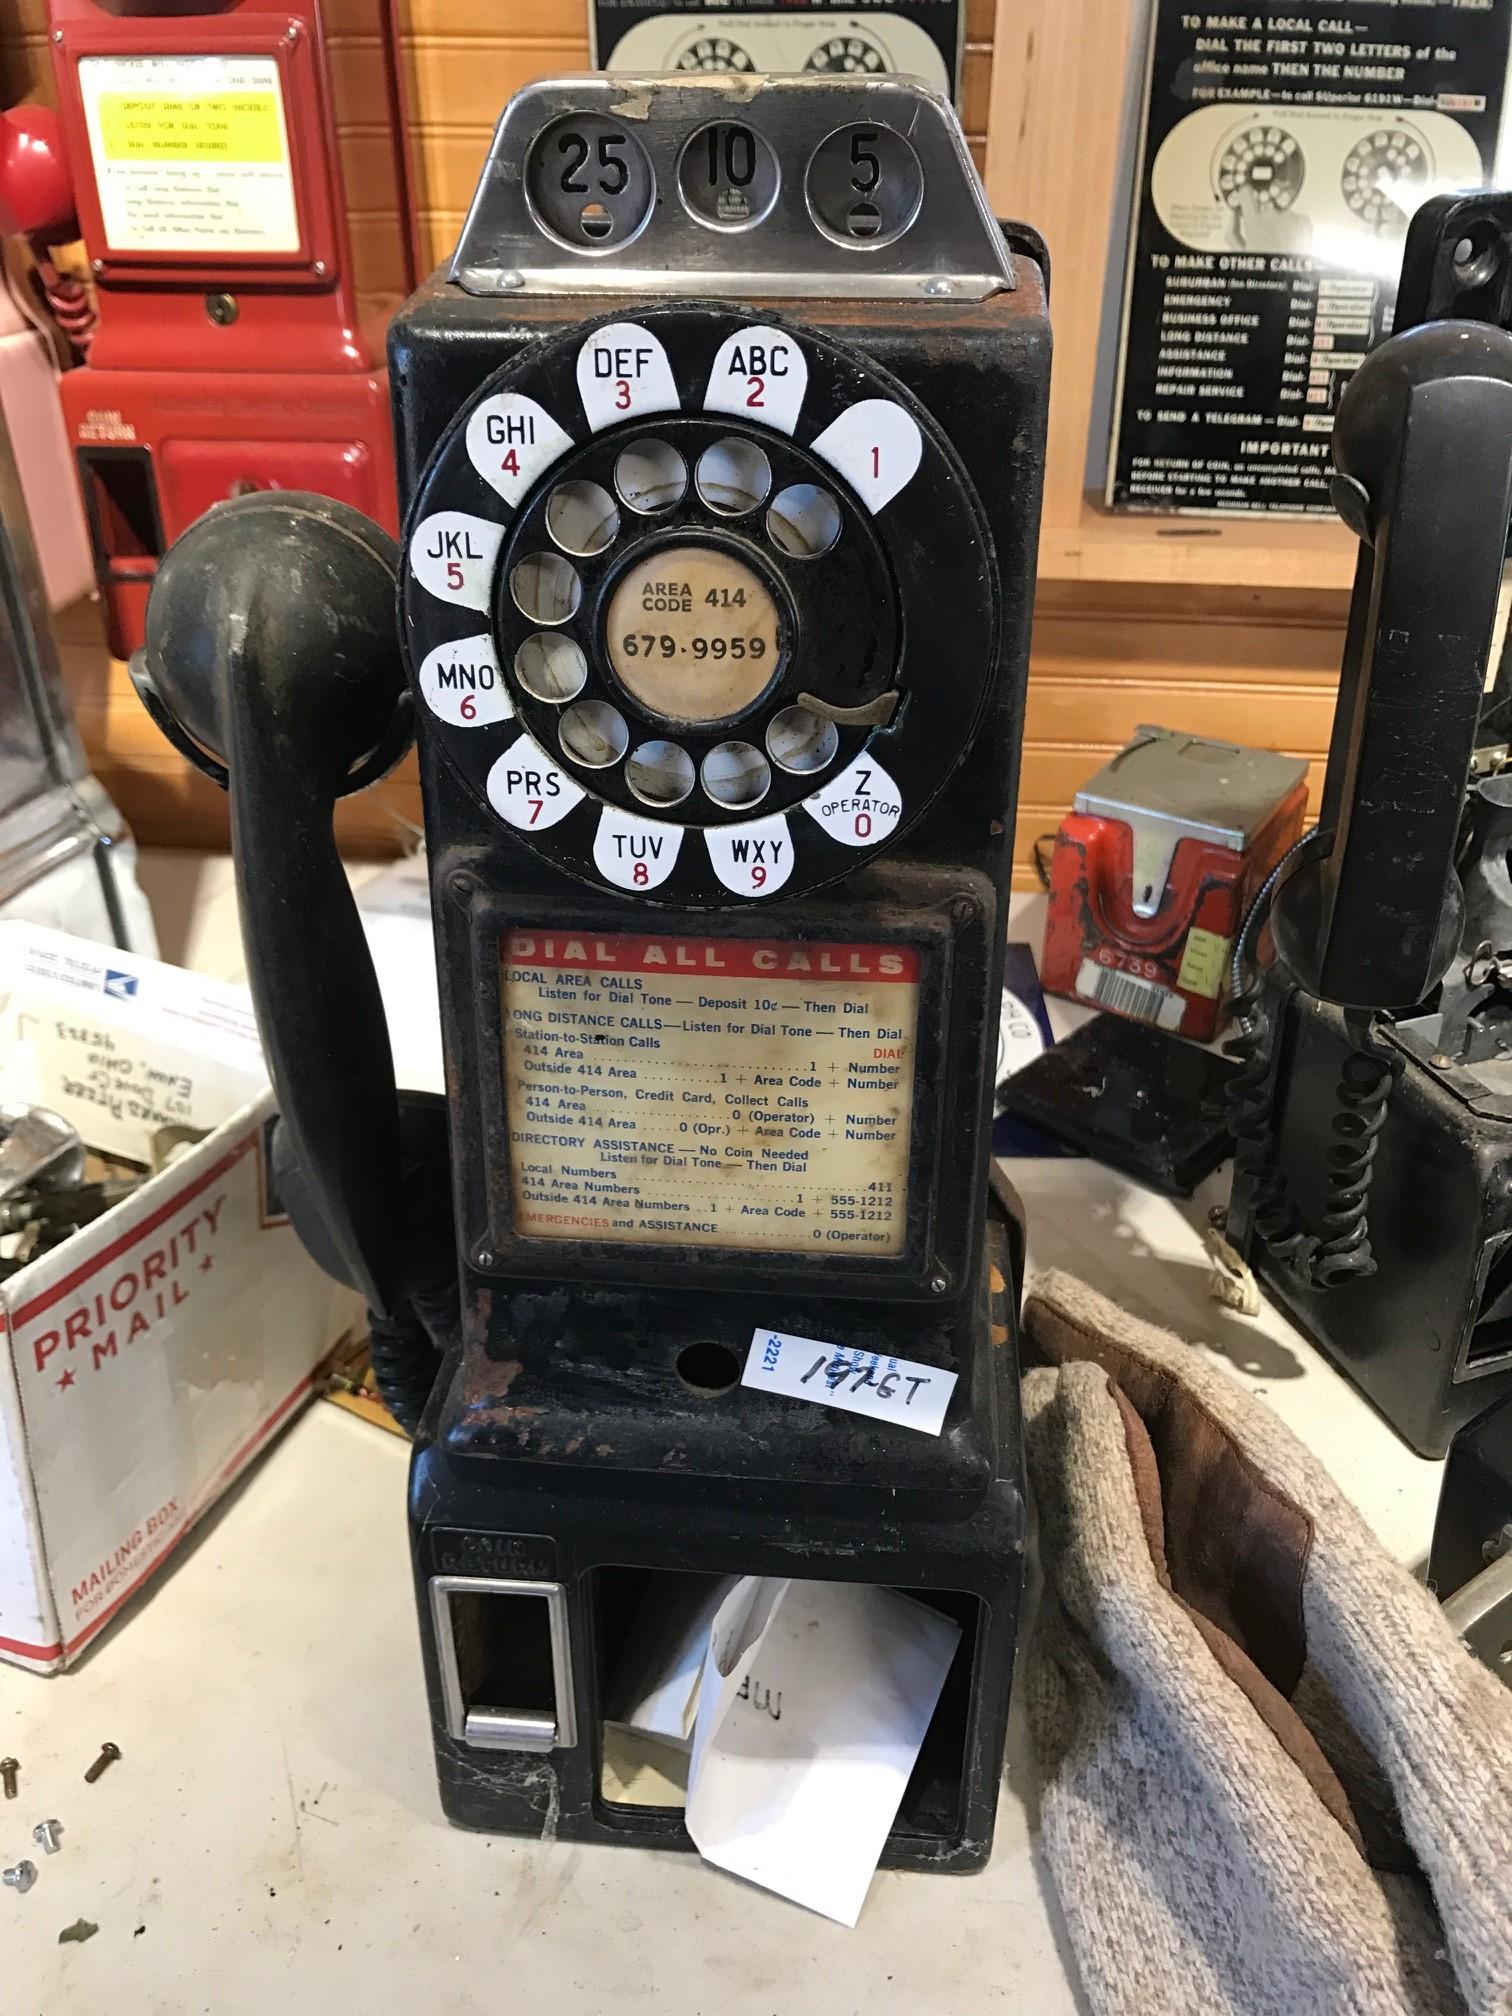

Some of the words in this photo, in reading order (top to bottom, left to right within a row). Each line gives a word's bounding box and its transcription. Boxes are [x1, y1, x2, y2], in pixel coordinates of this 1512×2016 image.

[1181, 15, 1201, 29] TO
[1206, 16, 1247, 31] MAKE
[1252, 17, 1262, 31] A
[1267, 17, 1313, 32] LOCAL
[1196, 37, 1228, 52] DIAL
[1234, 38, 1262, 53] THE
[1266, 39, 1307, 54] FIRST
[1313, 41, 1345, 56] TWO
[1350, 42, 1411, 60] LETTERS
[1416, 47, 1431, 60] of
[1435, 48, 1457, 61] the
[1193, 61, 1229, 74] office
[1233, 65, 1269, 76] name
[1272, 62, 1310, 78] THEN
[1313, 63, 1340, 79] THE
[1343, 65, 1405, 81] NUMBER
[558, 132, 629, 195] 25
[708, 125, 756, 187] 10
[850, 133, 880, 192] 5
[1151, 254, 1170, 269] TO
[1174, 255, 1215, 270] MAKE
[1219, 256, 1266, 271] OTHER
[594, 347, 653, 378] DEF
[728, 345, 789, 377] ABC
[615, 380, 631, 410] 3
[746, 376, 765, 407] 2
[485, 414, 535, 446] GHI
[501, 448, 520, 477] 4
[871, 446, 880, 478] 1
[1240, 440, 1330, 457] IMPORTANT
[427, 530, 483, 560] JKL
[446, 561, 464, 590] 5
[641, 582, 692, 597] AREA
[641, 597, 692, 613] CODE
[704, 588, 747, 609] 414
[437, 663, 494, 690] MNO
[460, 693, 477, 720] 6
[506, 770, 561, 797] PRS
[855, 770, 871, 796] Z
[528, 800, 544, 825] 7
[822, 798, 901, 818] OPERATOR
[854, 812, 871, 838] 0
[612, 833, 663, 860] TUV
[732, 839, 783, 864] WXY
[633, 861, 648, 886] 8
[751, 866, 767, 889] 9
[511, 937, 616, 962] DIAL
[642, 945, 725, 968] ALL
[752, 949, 904, 975] CALLS
[555, 973, 592, 987] AREA
[600, 976, 643, 990] CALLS
[538, 986, 577, 1000] Listen
[583, 989, 601, 1001] for
[609, 992, 634, 1004] Dial
[641, 993, 672, 1006] Tone
[698, 996, 747, 1011] Deposit
[754, 999, 778, 1011] 10¢
[804, 1001, 836, 1013] Then
[843, 1002, 868, 1015] Dial
[513, 1009, 542, 1022] ONG
[548, 1012, 615, 1027] DISTANCE
[727, 1022, 745, 1034] for
[751, 1023, 775, 1036] Dial
[781, 1025, 812, 1037] Tone
[838, 1027, 870, 1039] Then
[877, 1028, 902, 1040] Dial
[514, 1028, 625, 1047] Station-to-Station
[629, 1036, 661, 1049] Calls
[523, 1045, 548, 1057] 414
[554, 1047, 583, 1059] Area
[848, 1062, 900, 1074] Number
[873, 1048, 903, 1059] DIAL
[524, 1060, 572, 1074] Outside
[577, 1064, 602, 1076] 414
[608, 1067, 637, 1079] Area
[754, 1075, 783, 1086] Area
[789, 1076, 821, 1088] Code
[847, 1078, 899, 1090] Number
[518, 1079, 627, 1100] Person-to-Person,
[635, 1089, 674, 1101] Credit
[682, 1092, 716, 1105] Card,
[724, 1094, 769, 1106] Collect
[777, 1096, 809, 1108] Calls
[526, 1097, 550, 1108] 414
[558, 1099, 586, 1111] Area
[732, 1110, 740, 1120] 0
[749, 1110, 815, 1125] (Operator)
[846, 1114, 897, 1126] Number
[526, 1111, 573, 1125] Outside
[578, 1115, 603, 1127] 414
[607, 1118, 636, 1130] Area
[679, 1122, 688, 1133] 0
[693, 1123, 731, 1136] (Opr.)
[754, 1126, 784, 1138] Area
[789, 1127, 821, 1139] Code
[845, 1129, 896, 1141] Number
[511, 1131, 585, 1148] DIRECTORY
[593, 1138, 674, 1154] ASSISTANCE
[700, 1145, 717, 1156] No
[724, 1146, 753, 1158] Coin
[761, 1148, 809, 1160] Needed
[521, 1161, 552, 1174] Local
[561, 1165, 617, 1179] Numbers
[868, 1182, 893, 1192] 411
[600, 1151, 637, 1164] Listen
[641, 1153, 658, 1165] for
[663, 1155, 687, 1166] Dial
[691, 1157, 721, 1169] Tone
[746, 1160, 777, 1171] Then
[782, 1161, 807, 1173] Dial
[521, 1176, 545, 1187] 414
[551, 1178, 578, 1190] Area
[584, 1181, 640, 1195] Numbers
[831, 1195, 893, 1206] 555-1212
[523, 1190, 569, 1204] Outside
[573, 1195, 597, 1206] 414
[602, 1197, 630, 1208] Area
[635, 1199, 690, 1212] Numbers
[741, 1205, 769, 1216] Area
[774, 1207, 806, 1218] Code
[830, 1210, 892, 1221] 555-1212
[523, 1212, 609, 1227] MERGENCIES
[611, 1218, 634, 1229] and
[638, 1219, 718, 1233] ASSISTANCE
[813, 1229, 821, 1239] 0
[826, 1230, 891, 1243] (Operator)
[33, 1193, 227, 1372] PRIORITY
[92, 1280, 190, 1371] MAIL
[71, 1528, 143, 1606] MAILING
[146, 1497, 182, 1535] BOX
